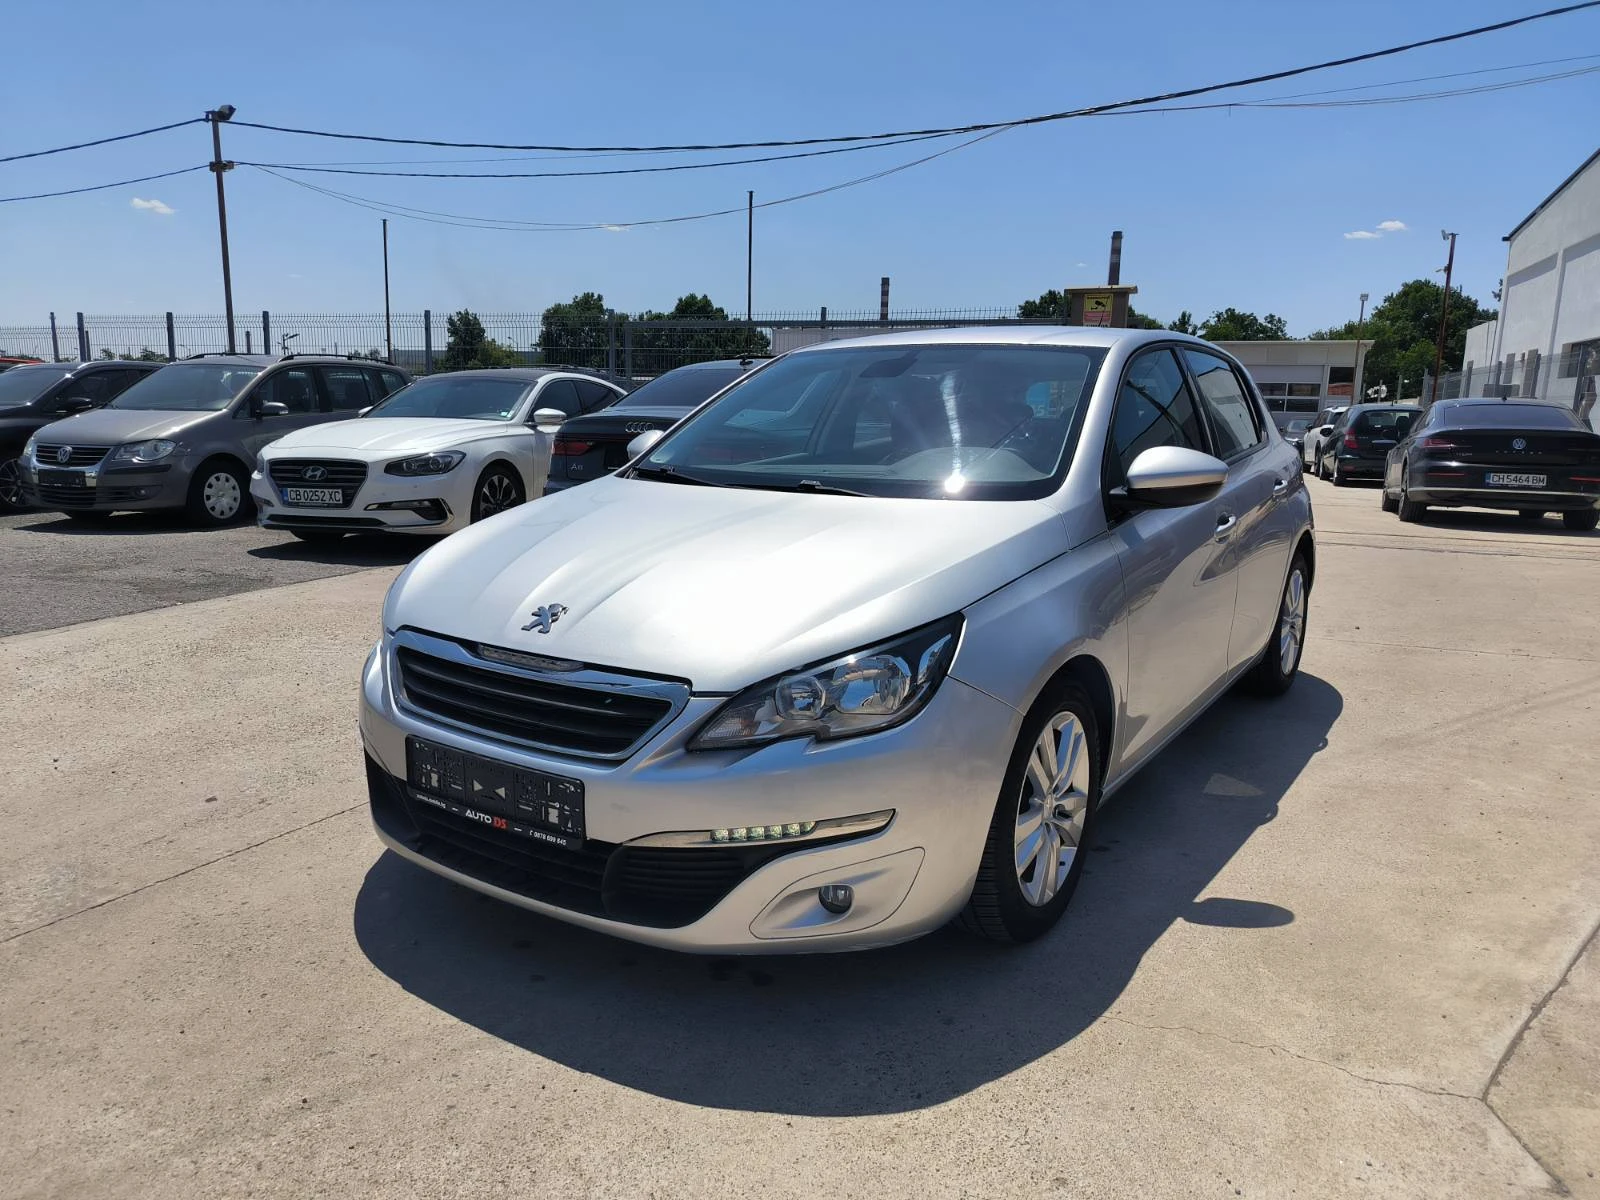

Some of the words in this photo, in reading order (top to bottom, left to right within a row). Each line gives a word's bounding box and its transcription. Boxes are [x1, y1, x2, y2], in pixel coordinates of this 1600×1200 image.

[1506, 474, 1530, 484] 5464
[289, 489, 302, 501] CB
[303, 490, 327, 502] 0252
[328, 490, 342, 503] XC
[465, 809, 492, 824] AUTO
[493, 816, 508, 829] DS
